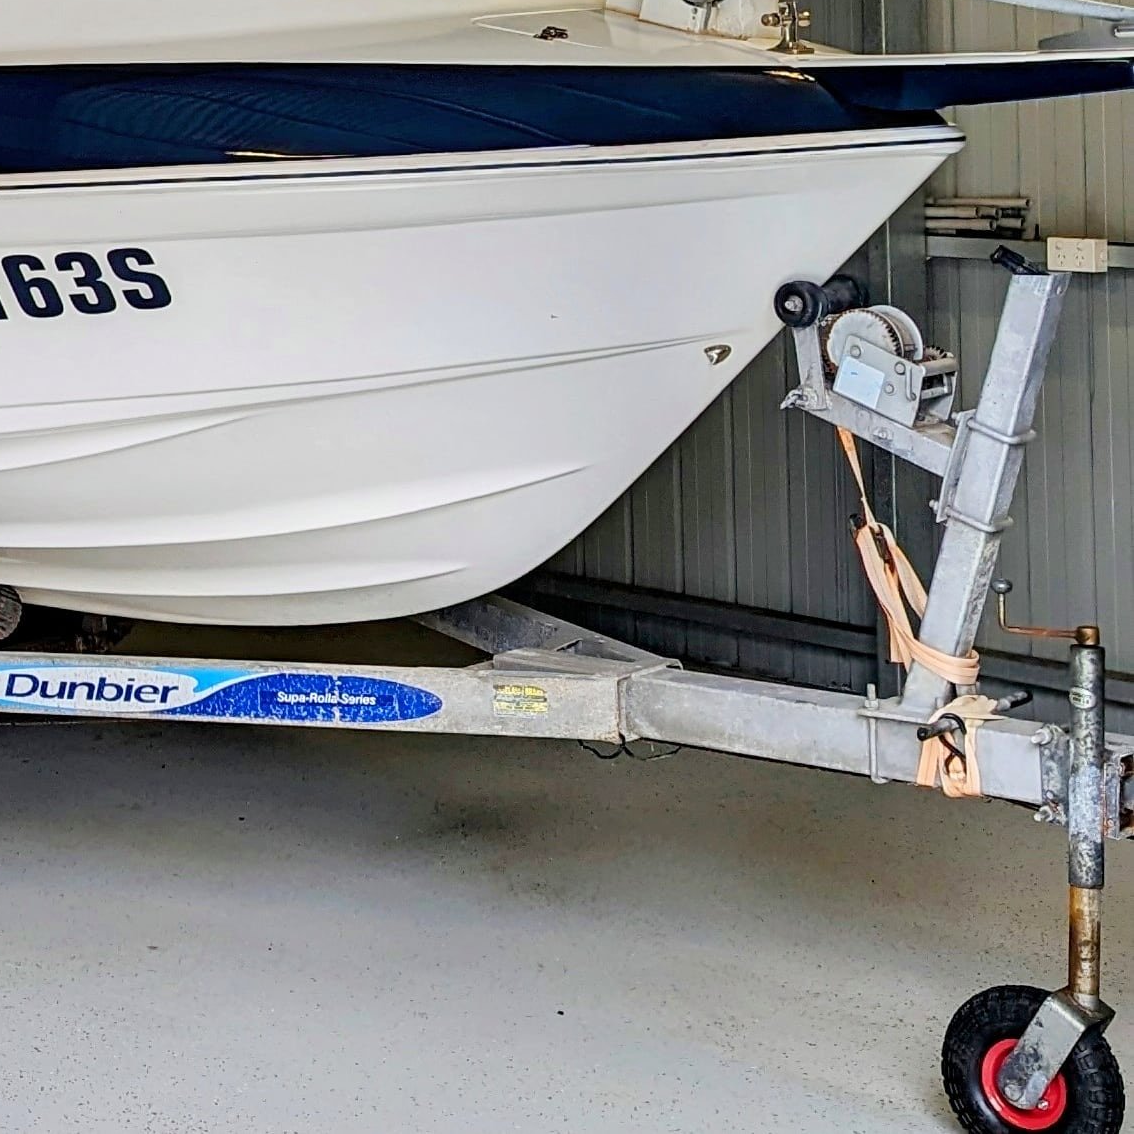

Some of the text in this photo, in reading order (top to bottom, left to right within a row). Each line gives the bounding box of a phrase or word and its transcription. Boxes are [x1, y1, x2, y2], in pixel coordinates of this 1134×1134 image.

[5, 673, 179, 704] Dunbier
[277, 691, 377, 705] Supa-Rolla Series
